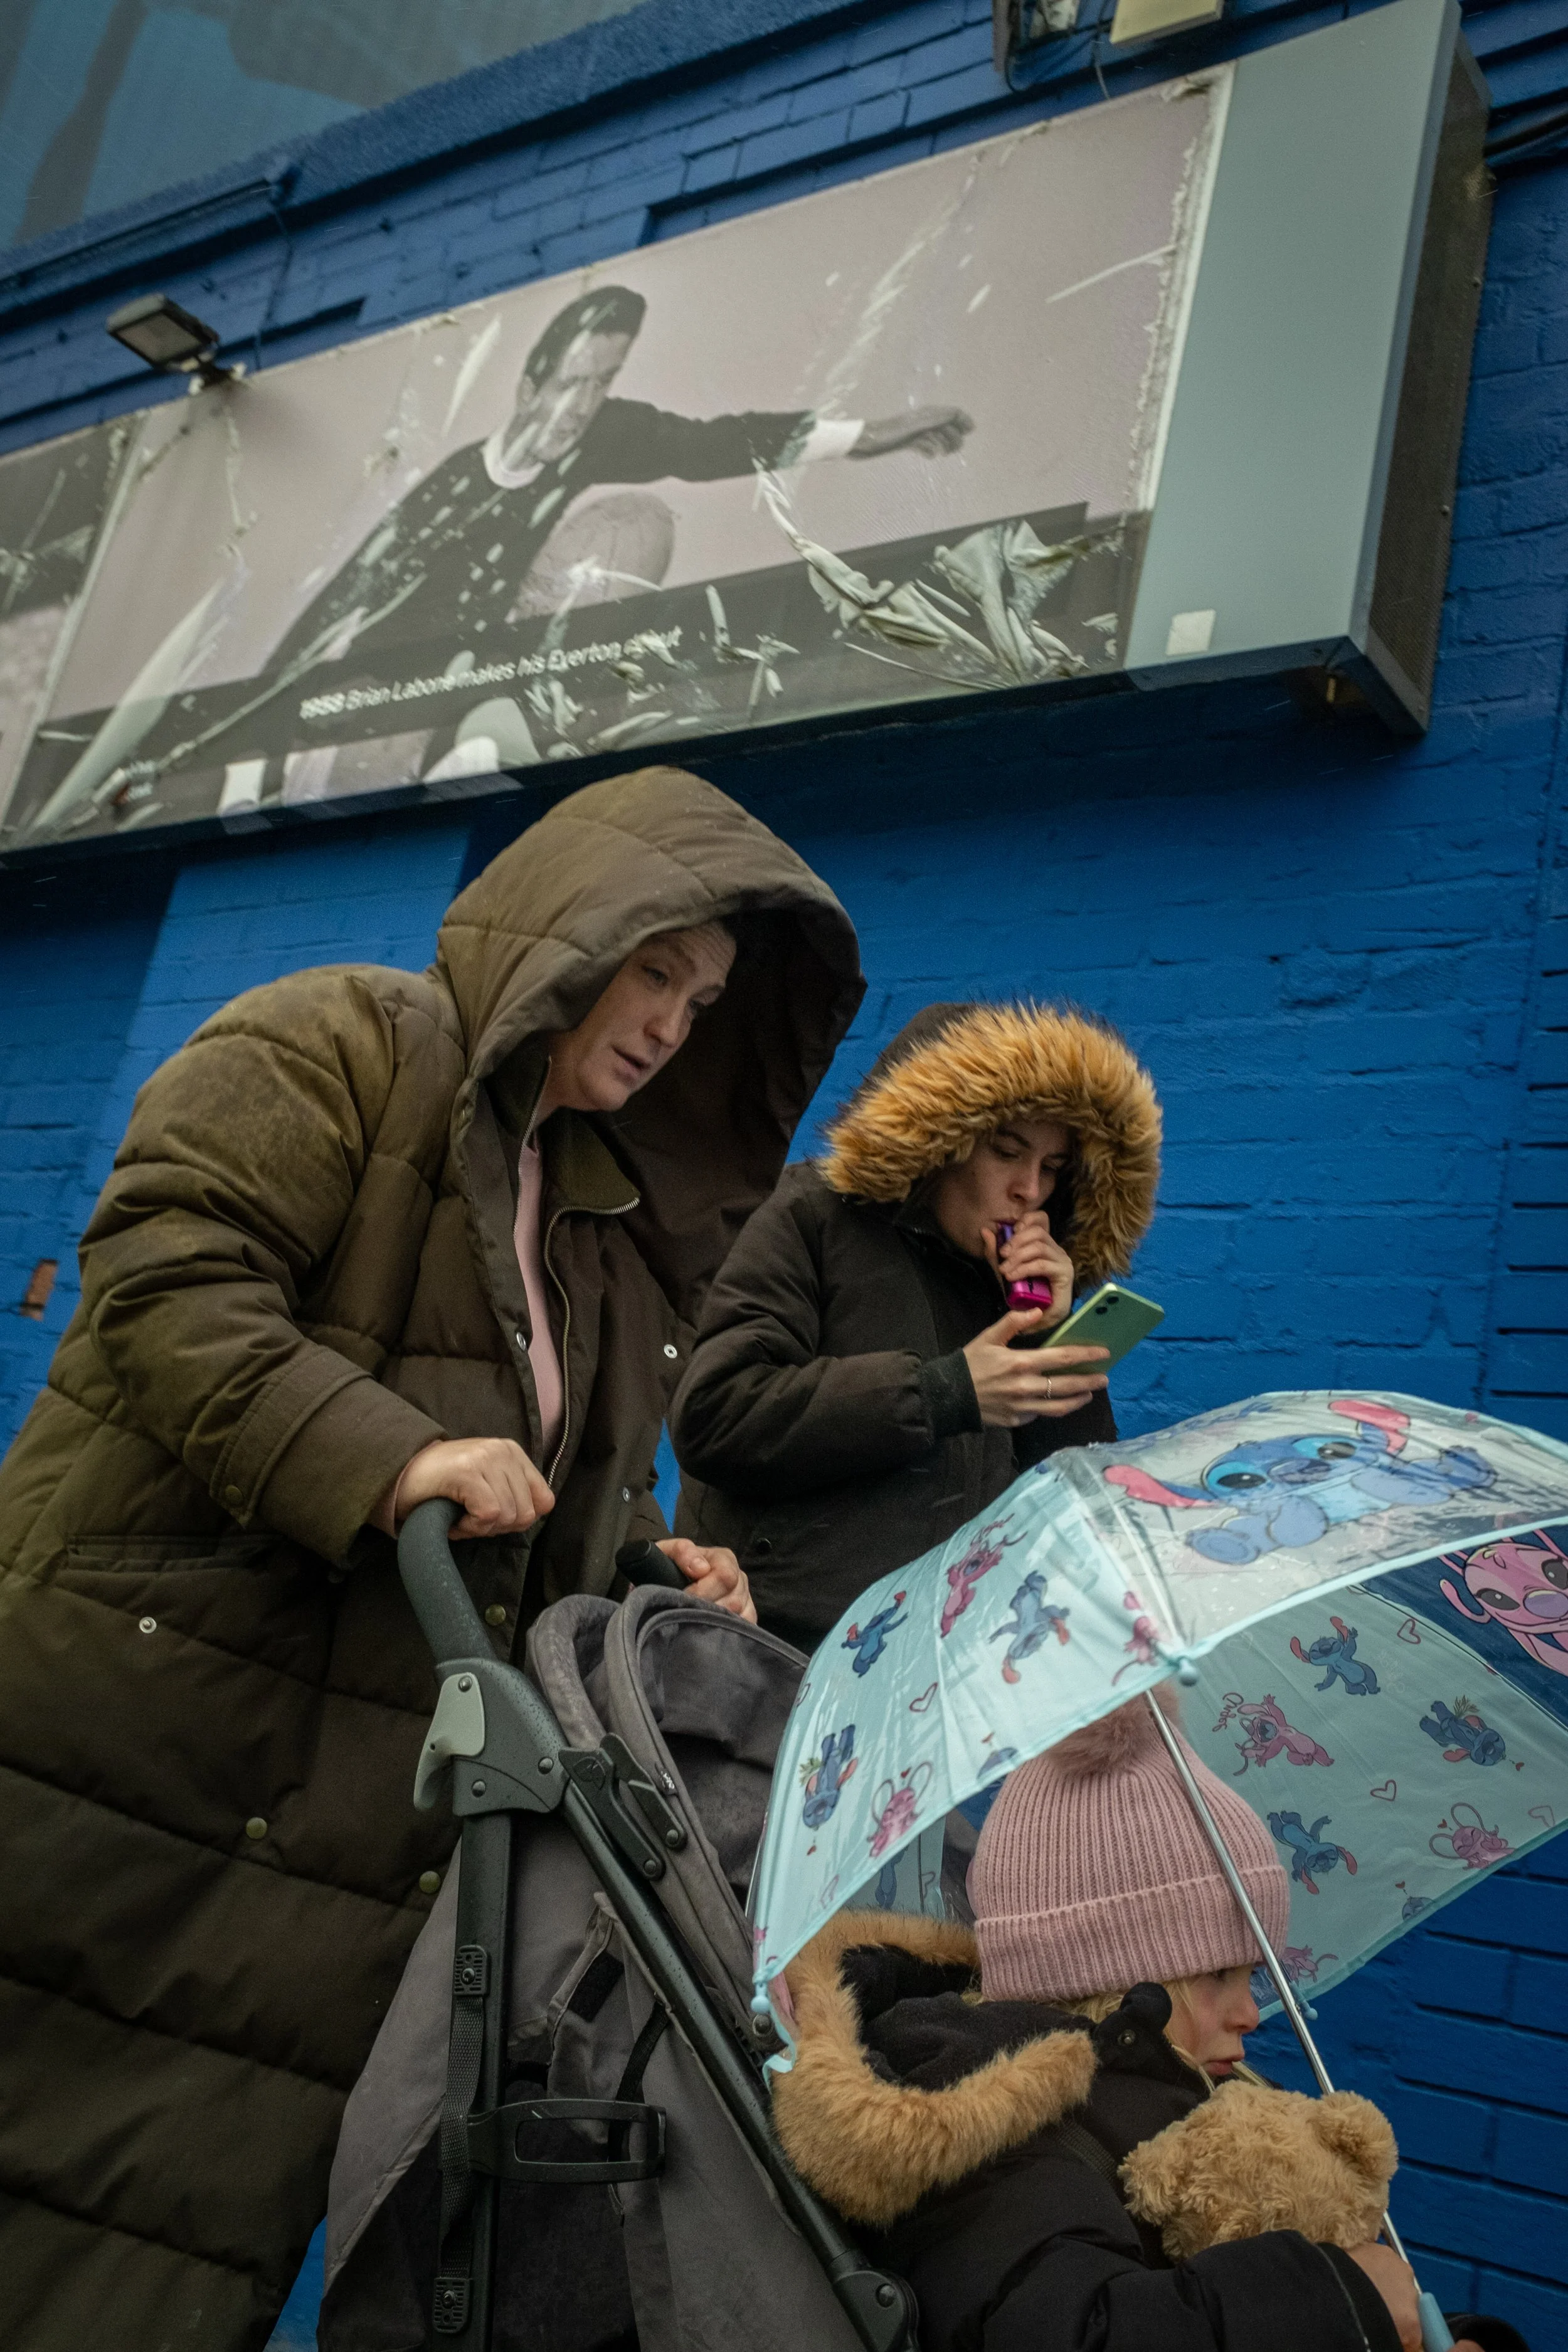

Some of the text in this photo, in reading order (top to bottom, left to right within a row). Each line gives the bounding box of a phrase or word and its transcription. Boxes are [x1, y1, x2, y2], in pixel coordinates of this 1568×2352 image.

[346, 686, 391, 710] Brian
[391, 674, 456, 701] Labone
[455, 662, 516, 689] makes
[517, 652, 546, 677] his
[547, 640, 622, 672] Everton
